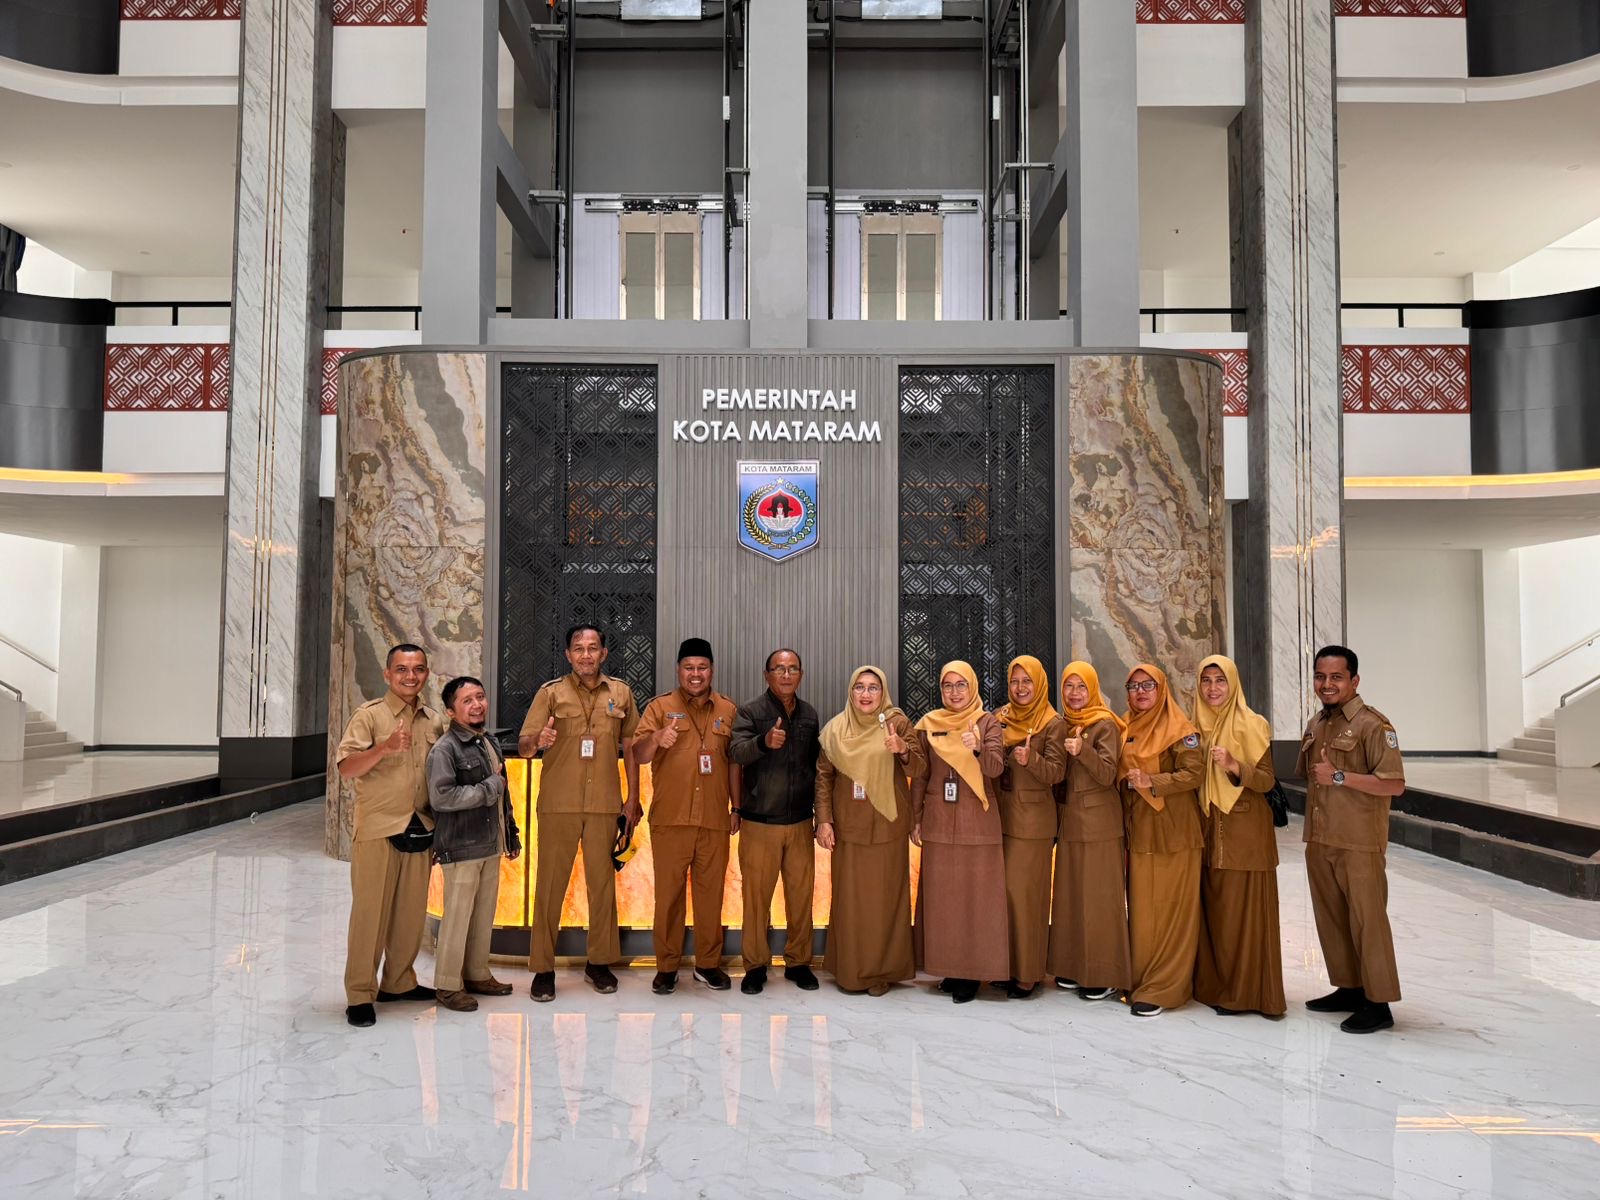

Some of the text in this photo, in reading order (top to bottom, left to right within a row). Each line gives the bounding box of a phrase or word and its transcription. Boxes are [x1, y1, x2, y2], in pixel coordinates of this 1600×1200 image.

[702, 389, 857, 410] PEMERINTAH
[673, 420, 882, 442] KOTA MATARAM
[744, 465, 812, 473] KOTA MATARAM
